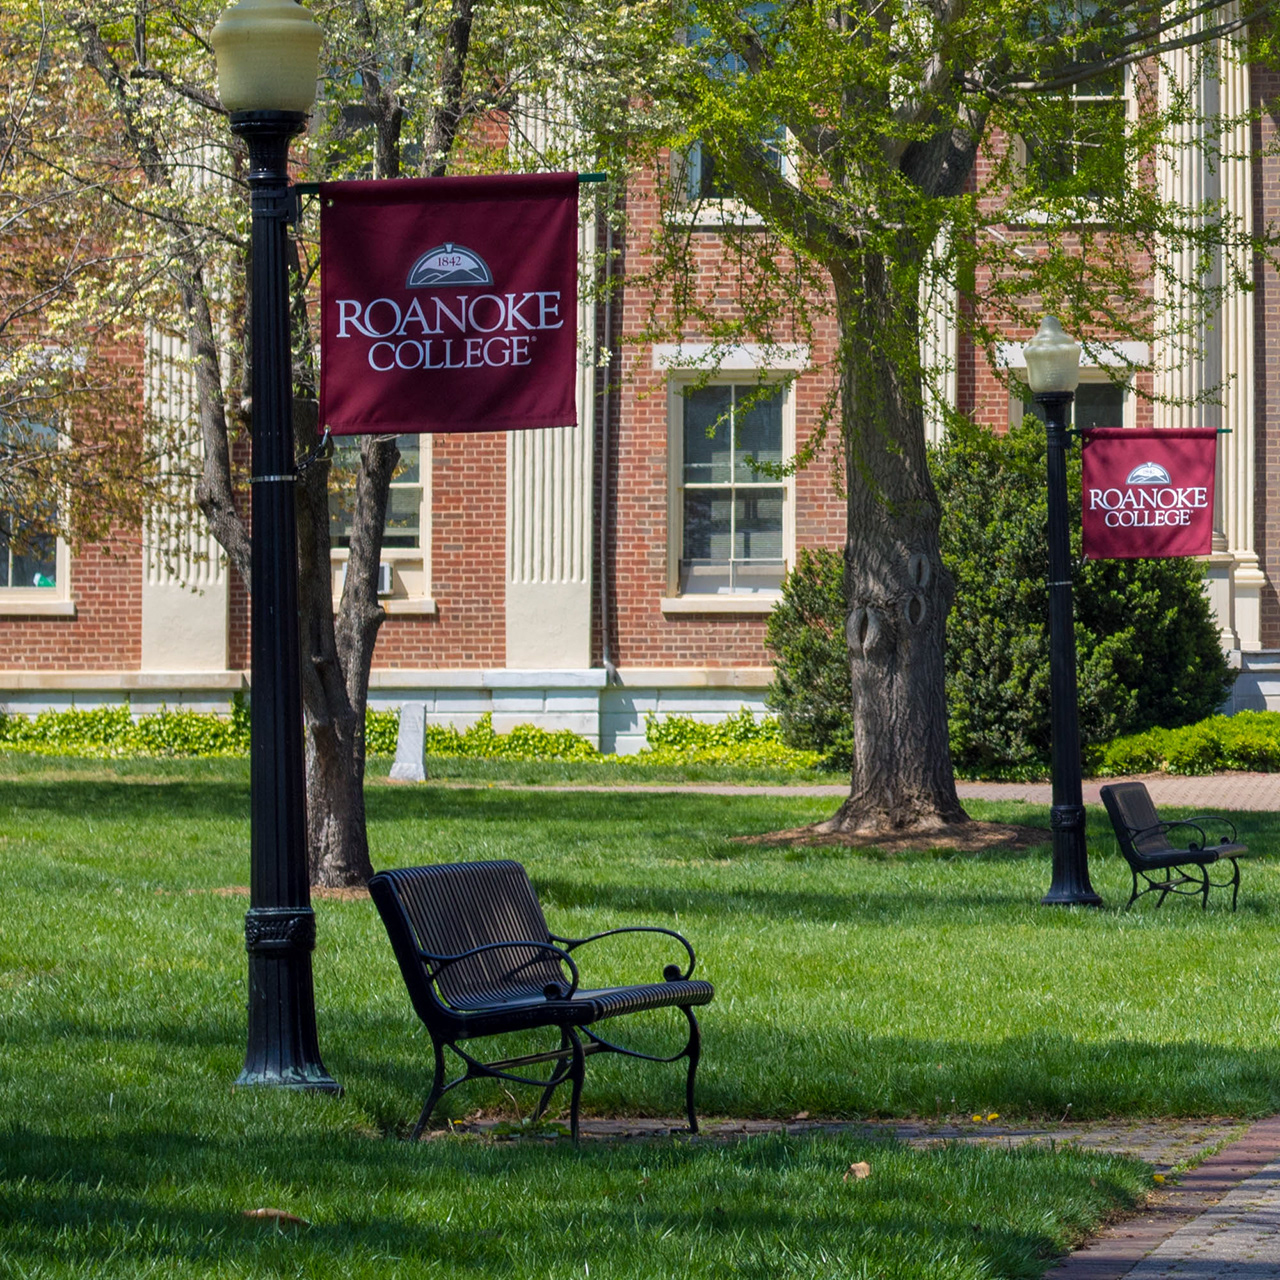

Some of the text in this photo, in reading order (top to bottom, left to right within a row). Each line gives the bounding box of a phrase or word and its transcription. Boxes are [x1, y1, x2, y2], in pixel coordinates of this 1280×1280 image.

[437, 256, 462, 267] 1842
[335, 291, 564, 338] ROANOKE
[368, 335, 532, 371] COLLEGE
[1089, 487, 1208, 510] ROANOKE
[1104, 509, 1191, 528] COLLEGE
